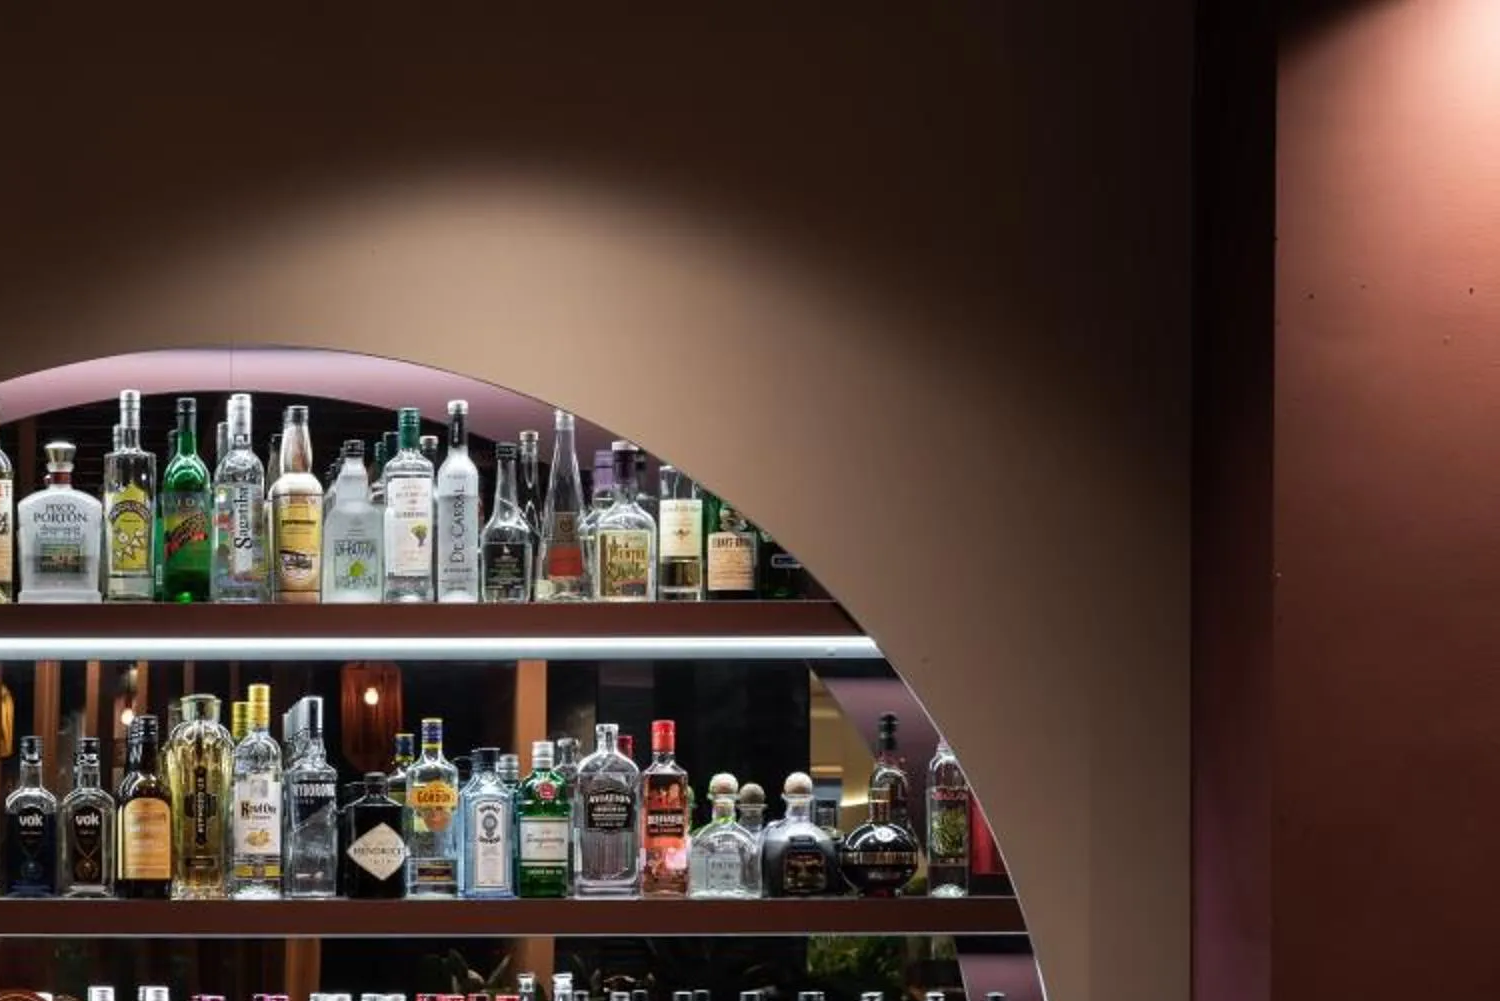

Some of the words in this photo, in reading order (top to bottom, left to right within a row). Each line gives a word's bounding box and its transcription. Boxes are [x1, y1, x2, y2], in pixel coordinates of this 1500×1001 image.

[46, 503, 76, 512] PISCO
[19, 813, 43, 826] vok
[75, 813, 100, 826] vok
